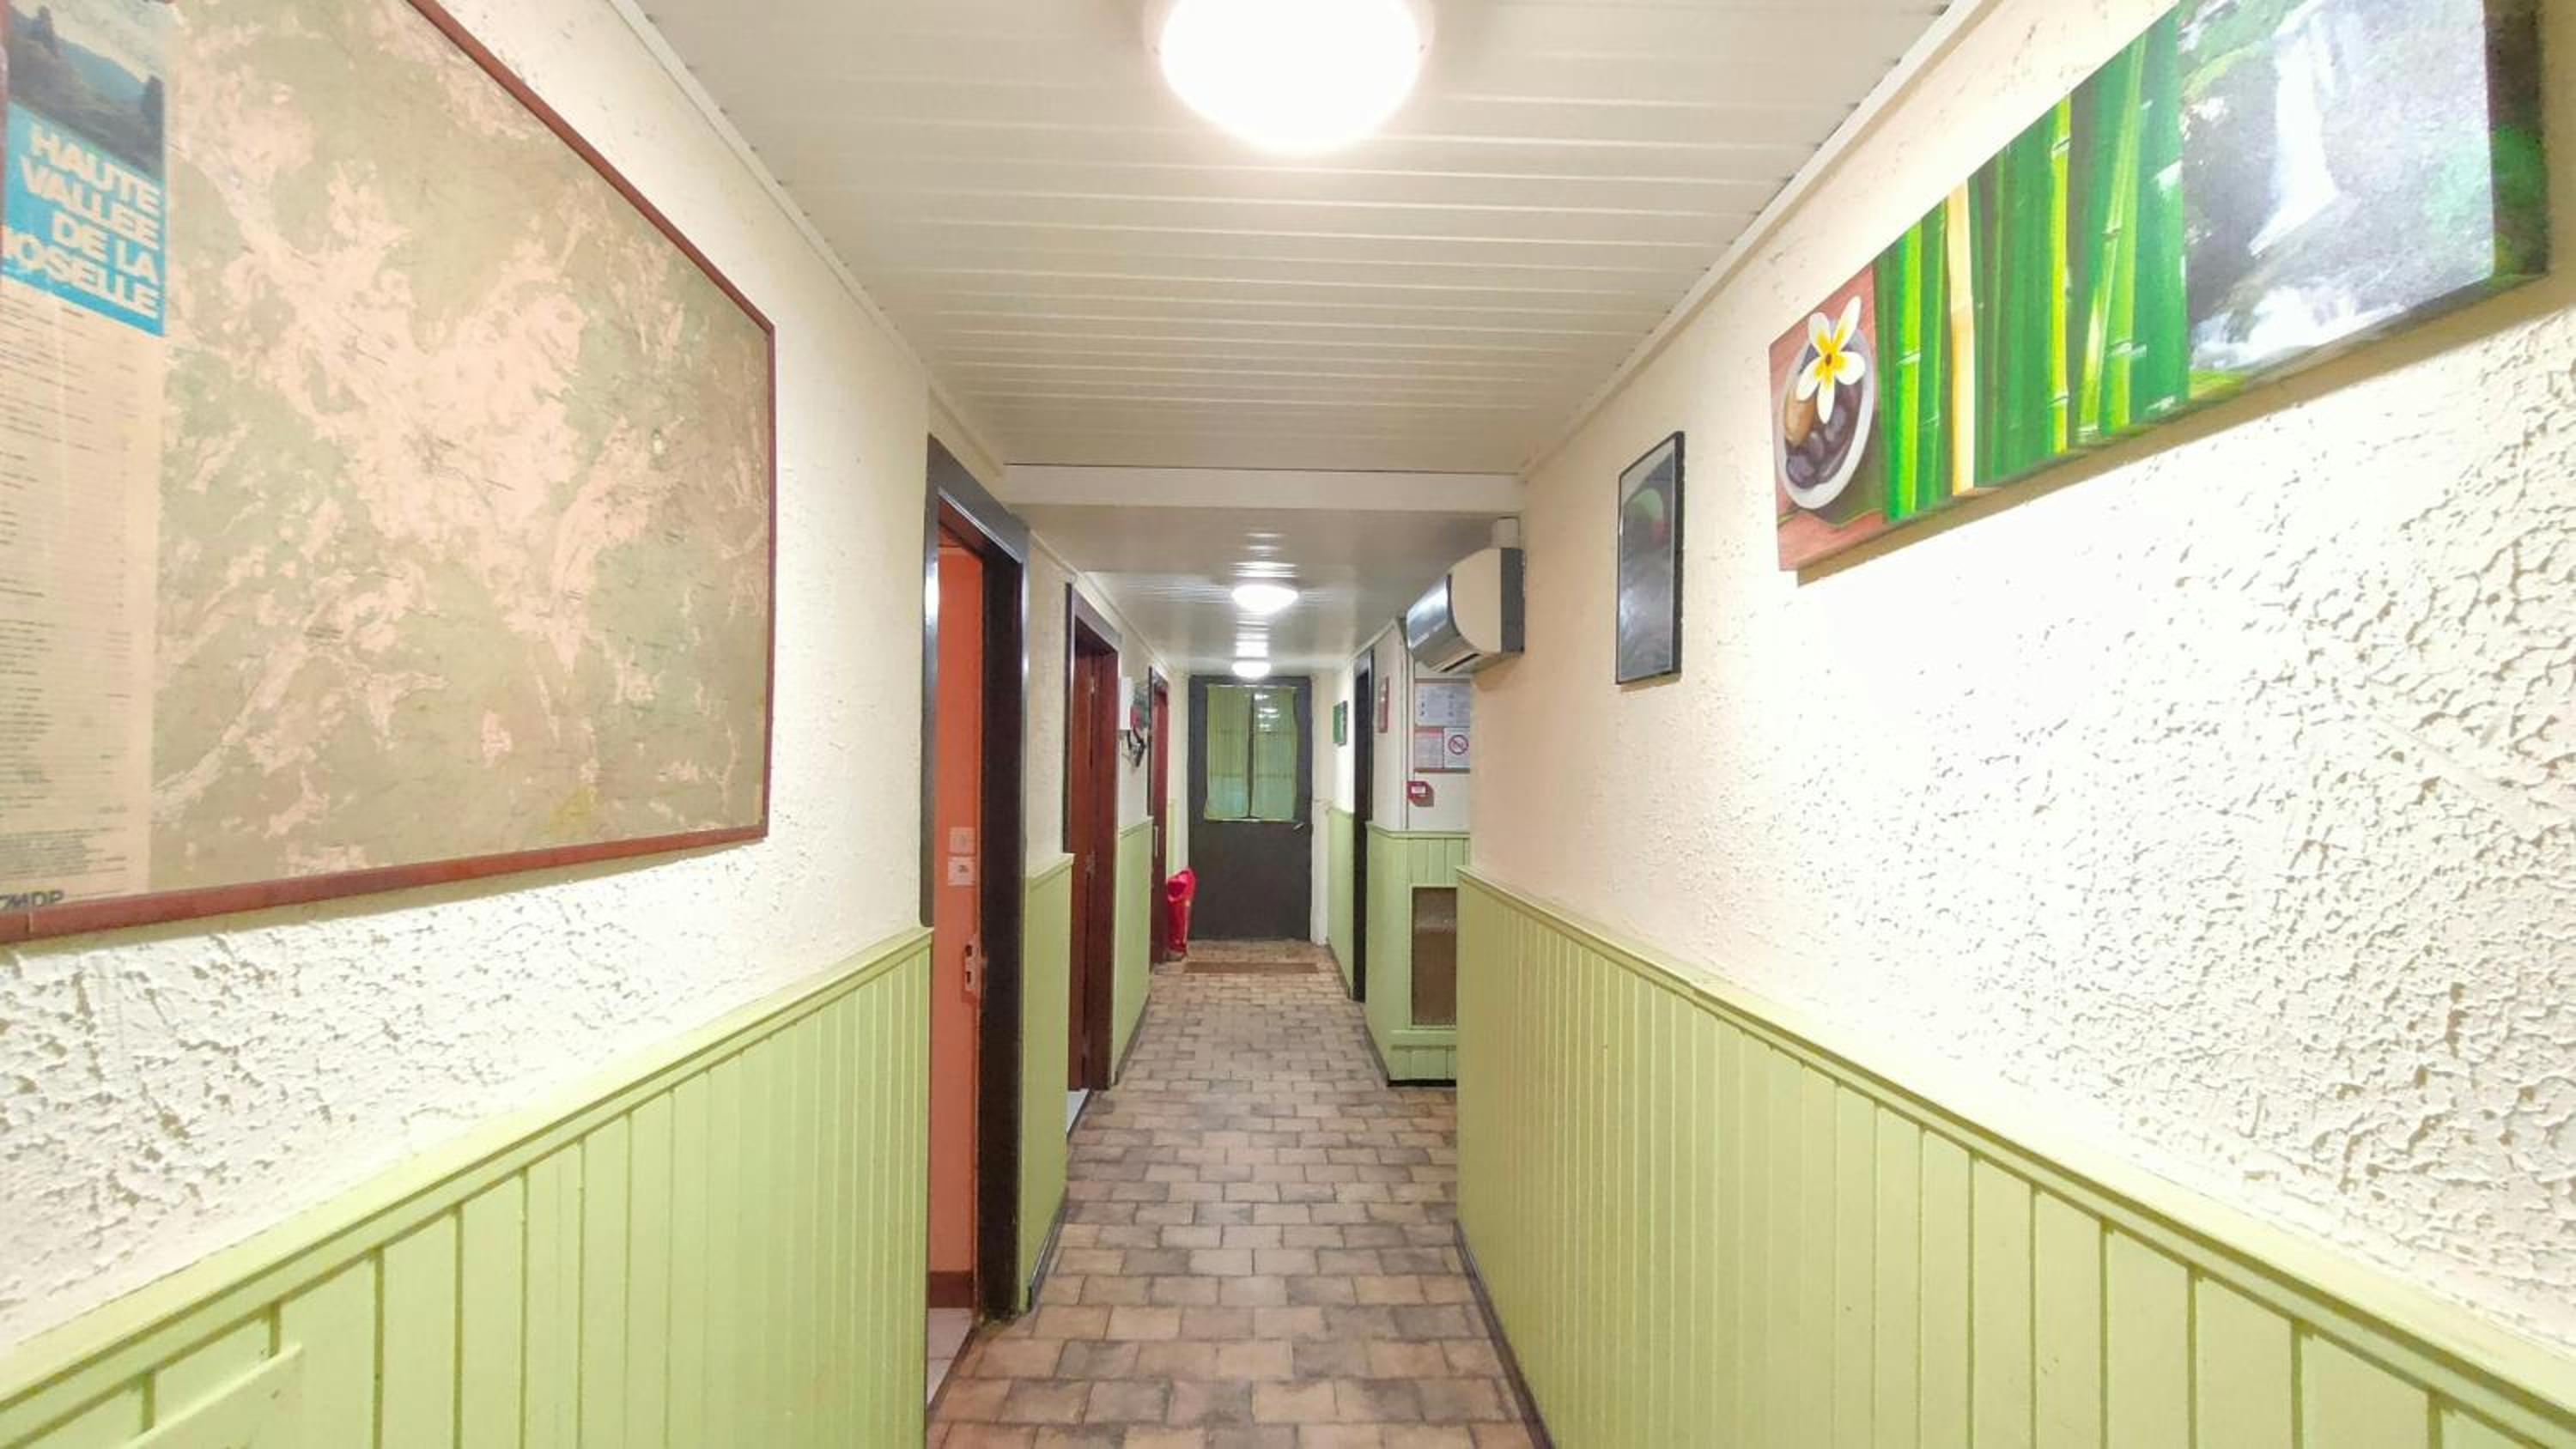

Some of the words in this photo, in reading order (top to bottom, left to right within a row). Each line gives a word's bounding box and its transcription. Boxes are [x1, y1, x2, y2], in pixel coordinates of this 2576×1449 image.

[20, 155, 161, 251] VALLEE
[29, 124, 161, 215] HAUTE
[53, 211, 108, 264] DE
[115, 239, 158, 287] LA
